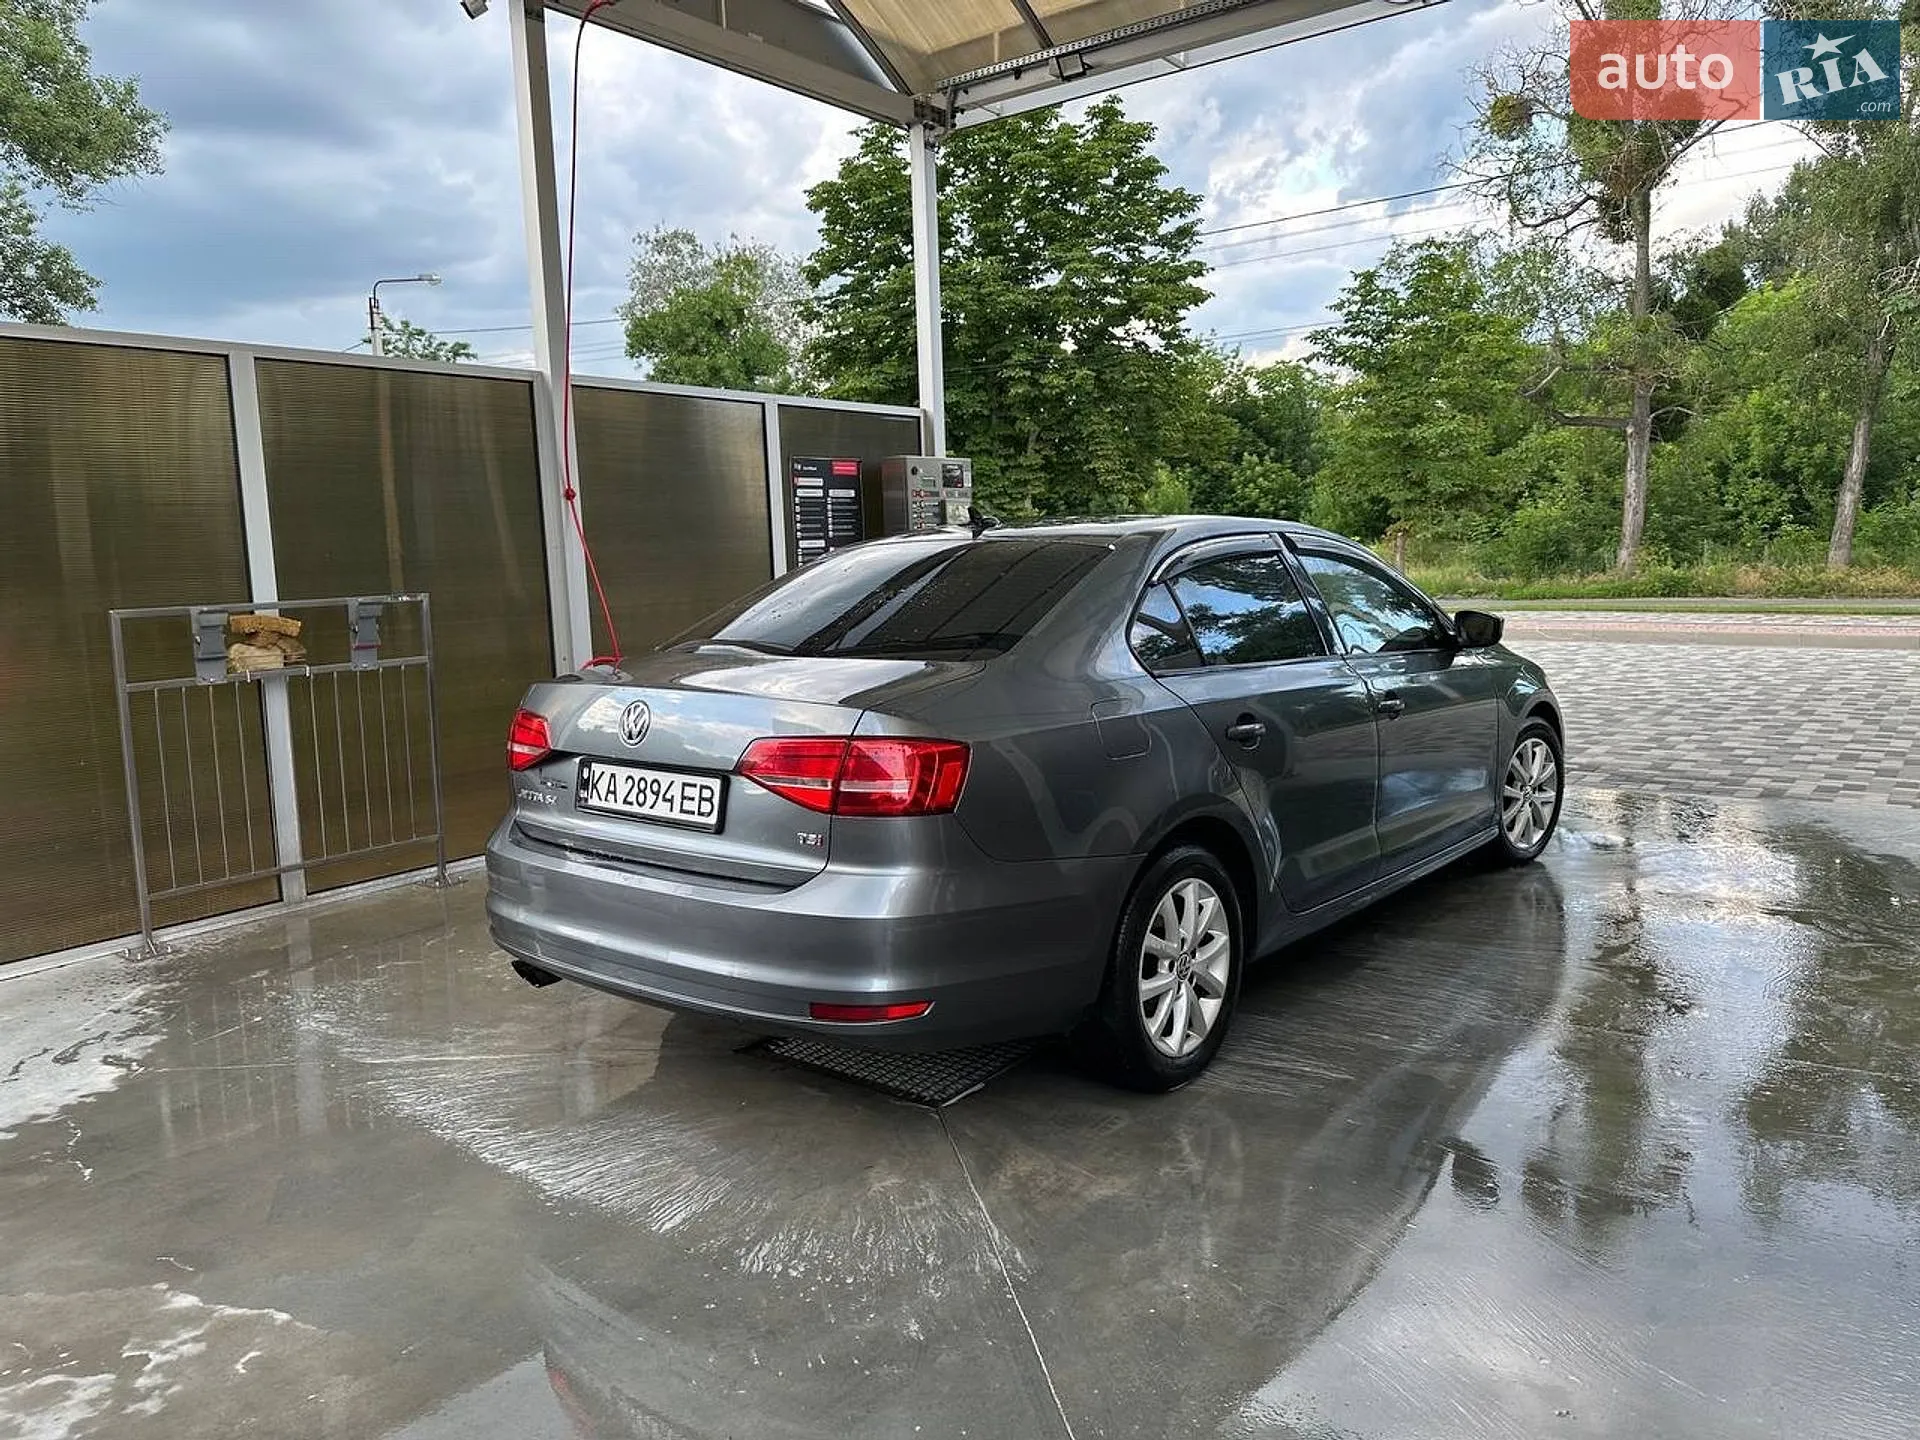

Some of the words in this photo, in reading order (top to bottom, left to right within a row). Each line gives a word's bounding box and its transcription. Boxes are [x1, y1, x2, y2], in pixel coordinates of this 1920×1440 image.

[620, 700, 650, 746] VW
[589, 769, 618, 804] KA
[622, 775, 676, 813] 2894
[679, 781, 715, 818] EB
